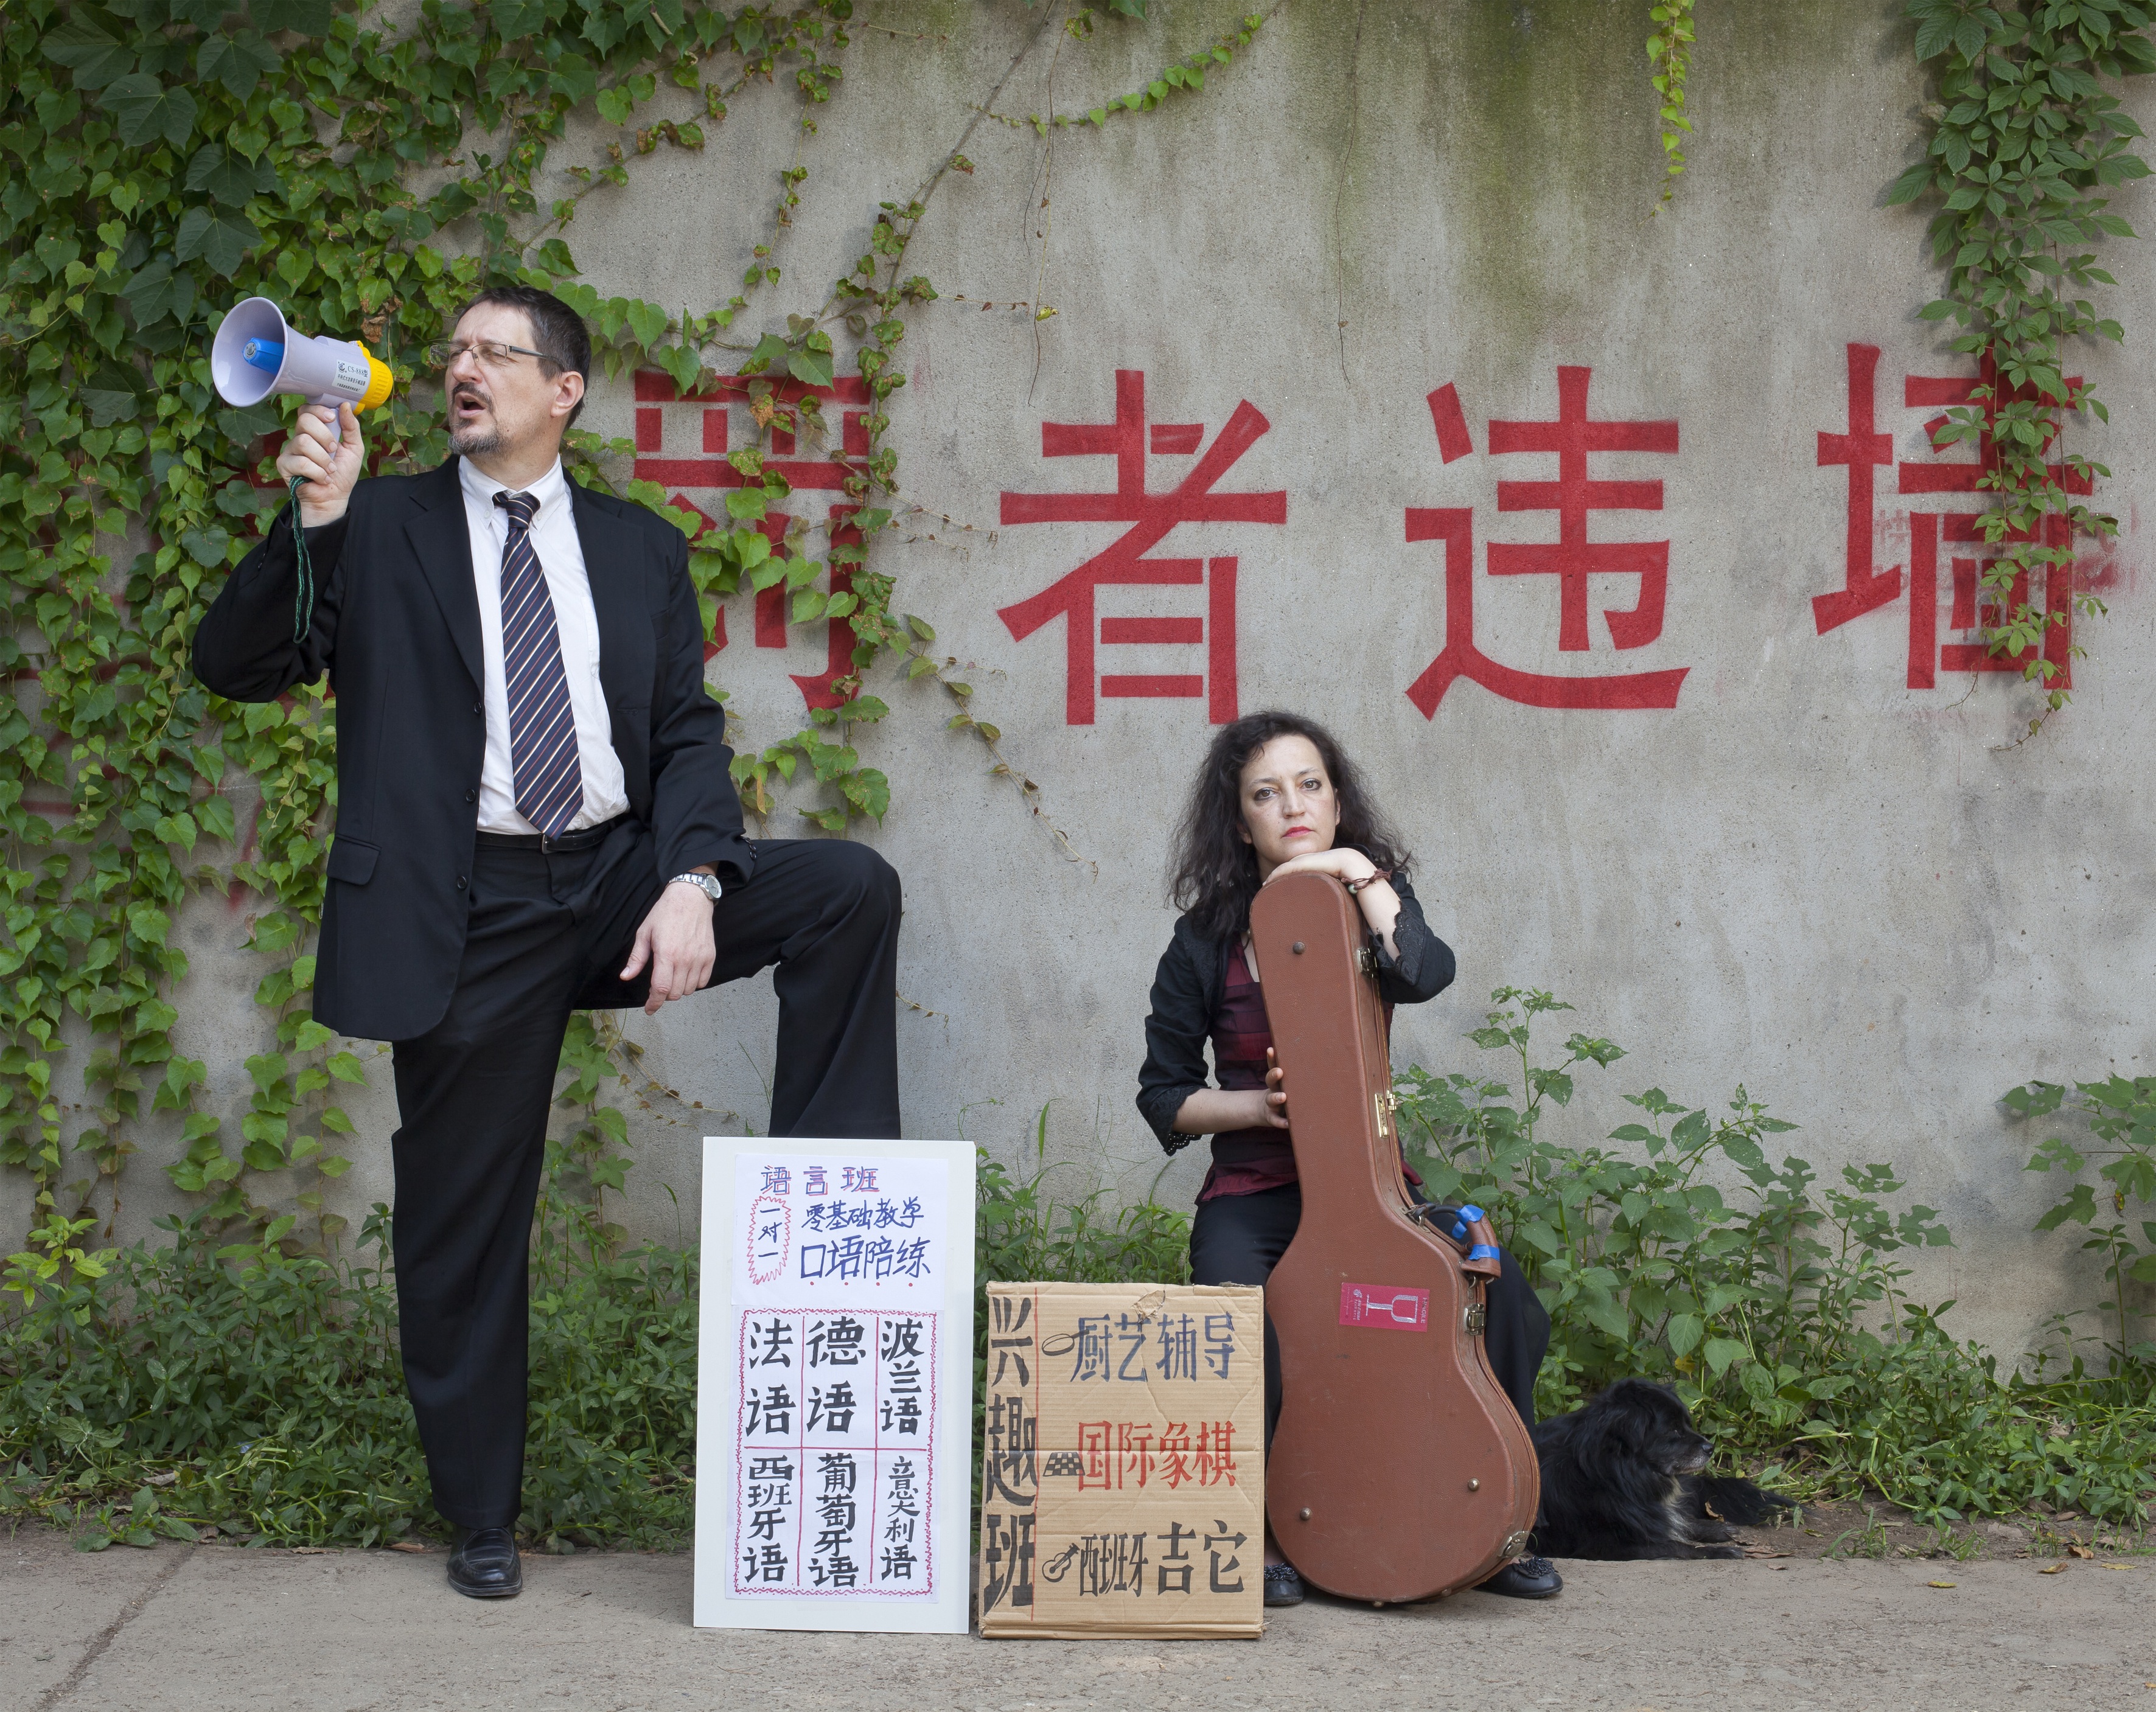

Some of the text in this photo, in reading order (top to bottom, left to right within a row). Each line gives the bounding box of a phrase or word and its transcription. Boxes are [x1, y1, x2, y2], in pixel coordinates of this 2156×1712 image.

[758, 1208, 783, 1257] 一对一
[800, 1235, 931, 1279] 口语陪练
[801, 1196, 924, 1232] 零基础教学
[745, 1317, 796, 1436] 法语
[807, 1316, 865, 1433] 德语
[880, 1317, 924, 1435] 波兰语
[1070, 1311, 1235, 1383] 厨艺辅导
[983, 1296, 1038, 1616] 兴趣班
[1078, 1421, 1237, 1492] 国际象棋
[742, 1455, 795, 1582] 西班牙语
[808, 1452, 859, 1587] 葡萄牙语
[880, 1456, 920, 1581] 意大利语
[1080, 1519, 1247, 1597] 西班牙吉它
